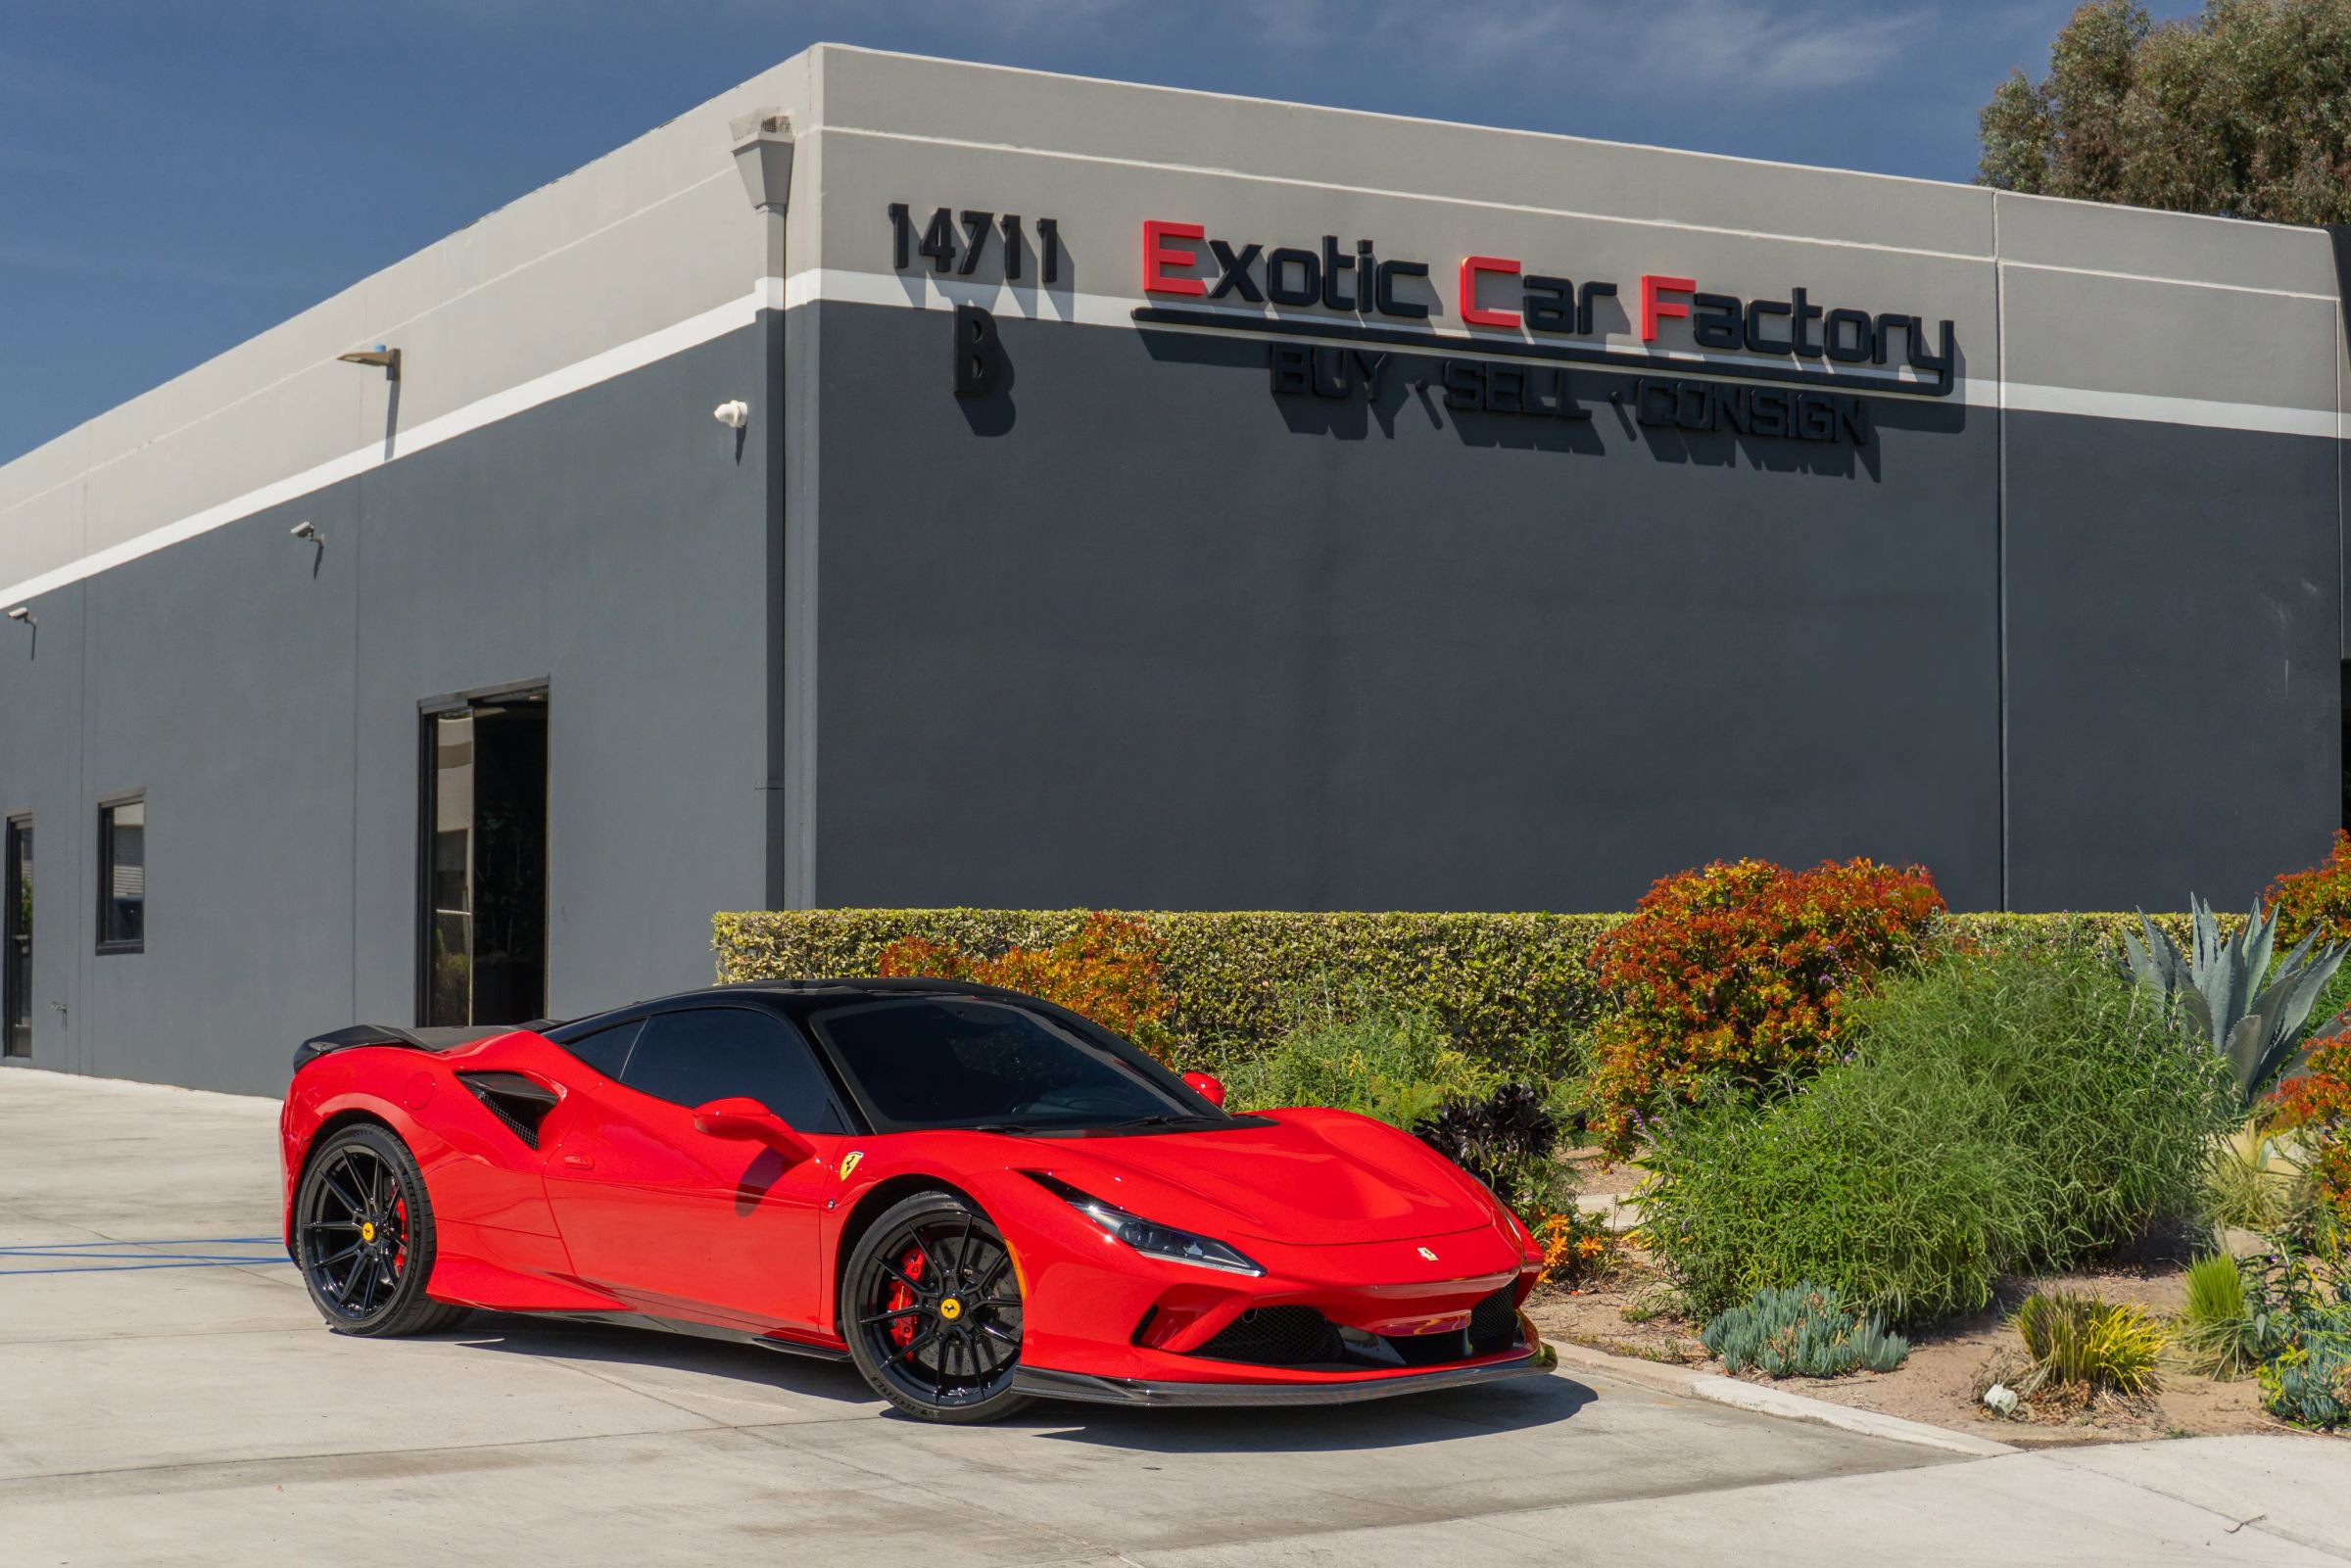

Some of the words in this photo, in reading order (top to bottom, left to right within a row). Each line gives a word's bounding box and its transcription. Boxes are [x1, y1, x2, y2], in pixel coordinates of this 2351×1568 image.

[888, 203, 1058, 283] 14711
[953, 305, 999, 396] B
[1143, 219, 1429, 319] Exotic
[1460, 256, 1618, 335] Car
[1641, 274, 1955, 397] Factory
[1270, 342, 1392, 403] BUY
[1442, 358, 1593, 421] SELL
[1635, 375, 1870, 447] CONSIGN
